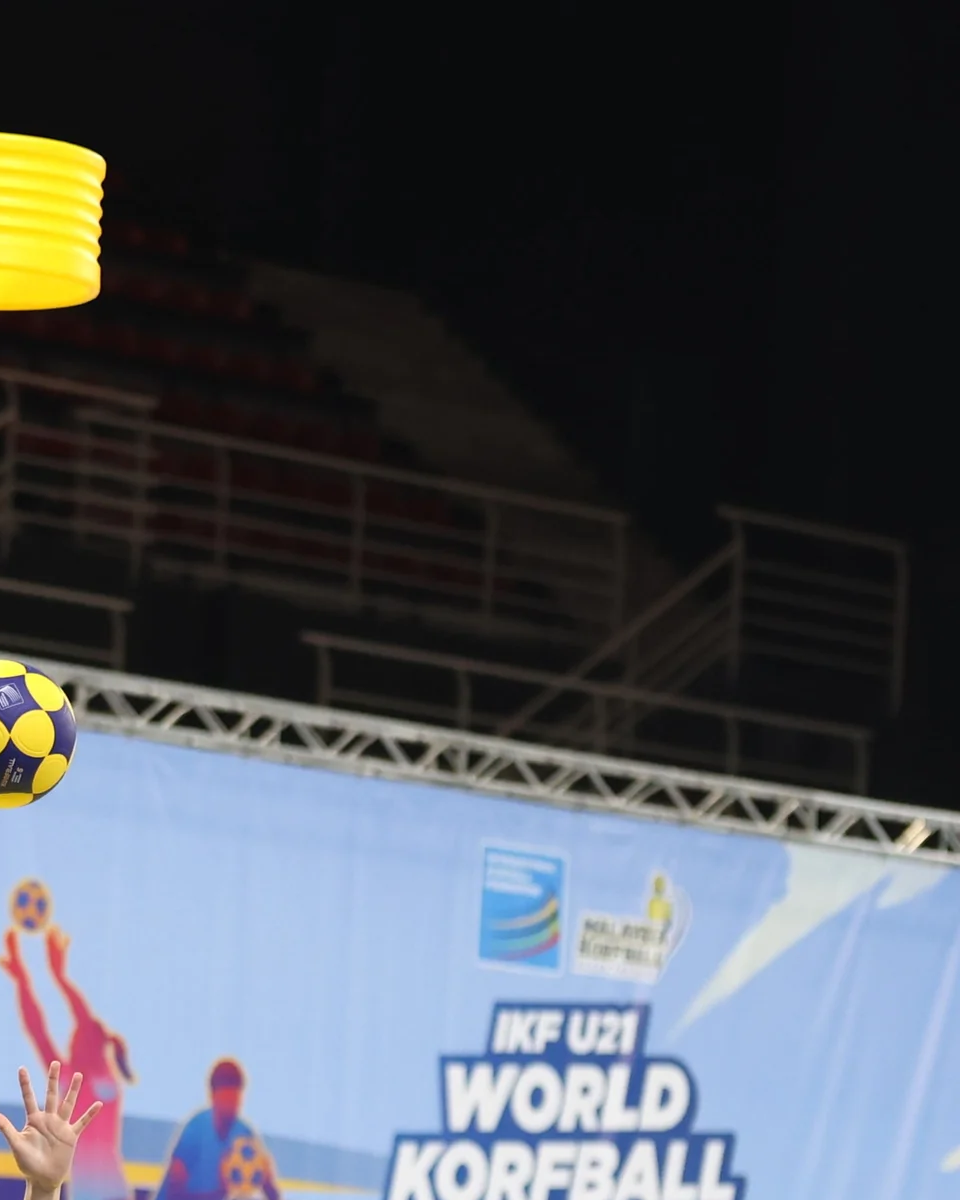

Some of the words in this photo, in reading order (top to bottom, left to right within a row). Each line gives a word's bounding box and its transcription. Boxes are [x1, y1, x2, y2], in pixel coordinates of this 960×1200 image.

[492, 1009, 565, 1055] IKF
[567, 1009, 640, 1056] U21
[444, 1061, 691, 1134] WORLD
